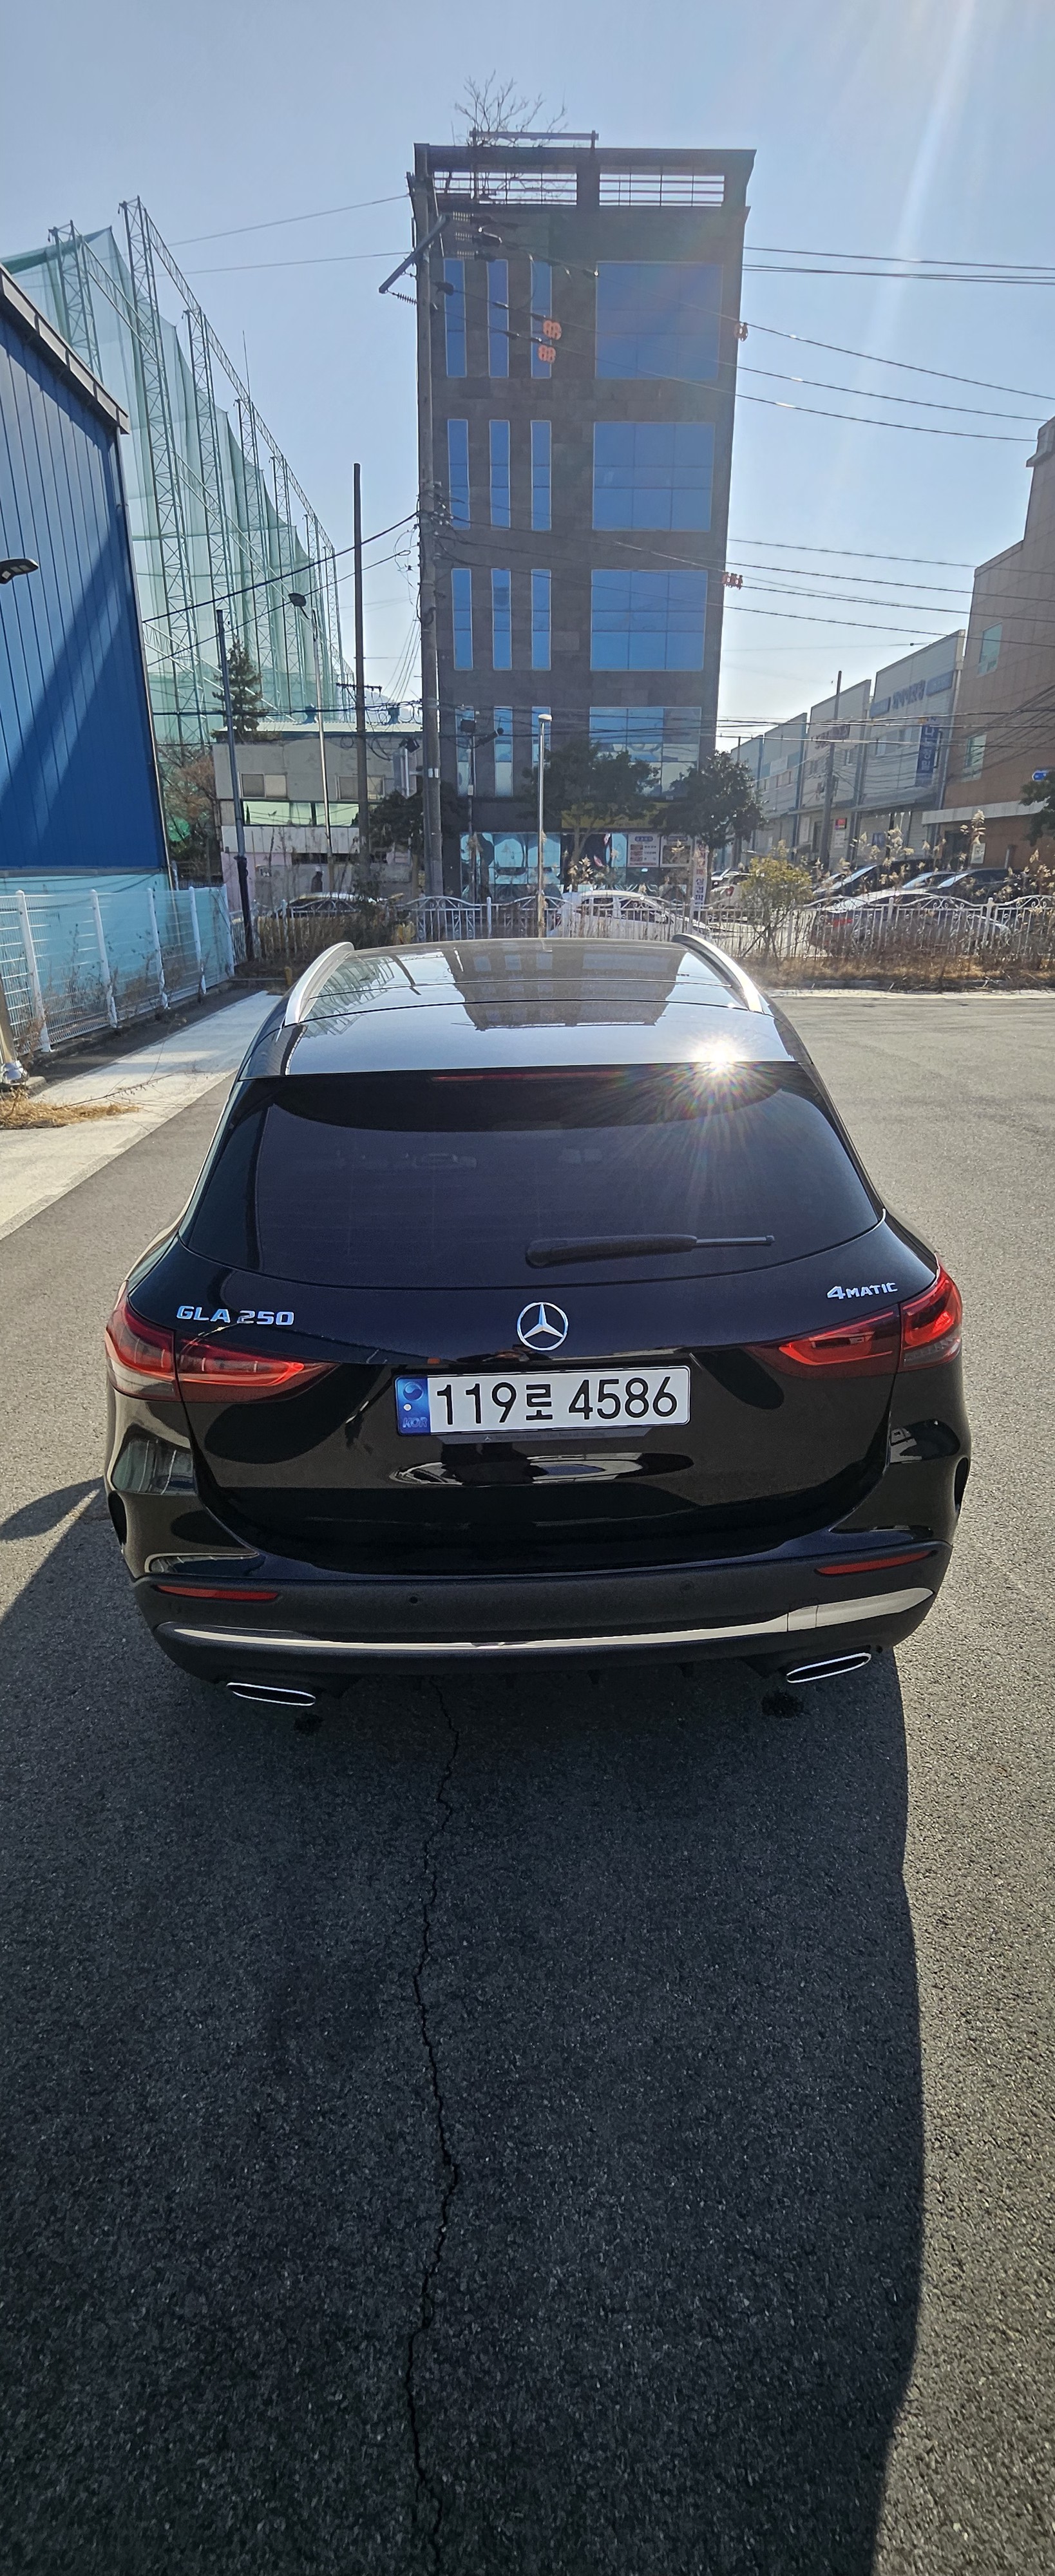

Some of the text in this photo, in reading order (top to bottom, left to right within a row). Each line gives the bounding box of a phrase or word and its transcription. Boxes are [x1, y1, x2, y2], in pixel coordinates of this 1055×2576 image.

[826, 1282, 898, 1300] 4MATIC
[176, 1305, 294, 1325] GLA 250
[437, 1376, 678, 1425] 119로 4586
[403, 1416, 428, 1428] KOR
